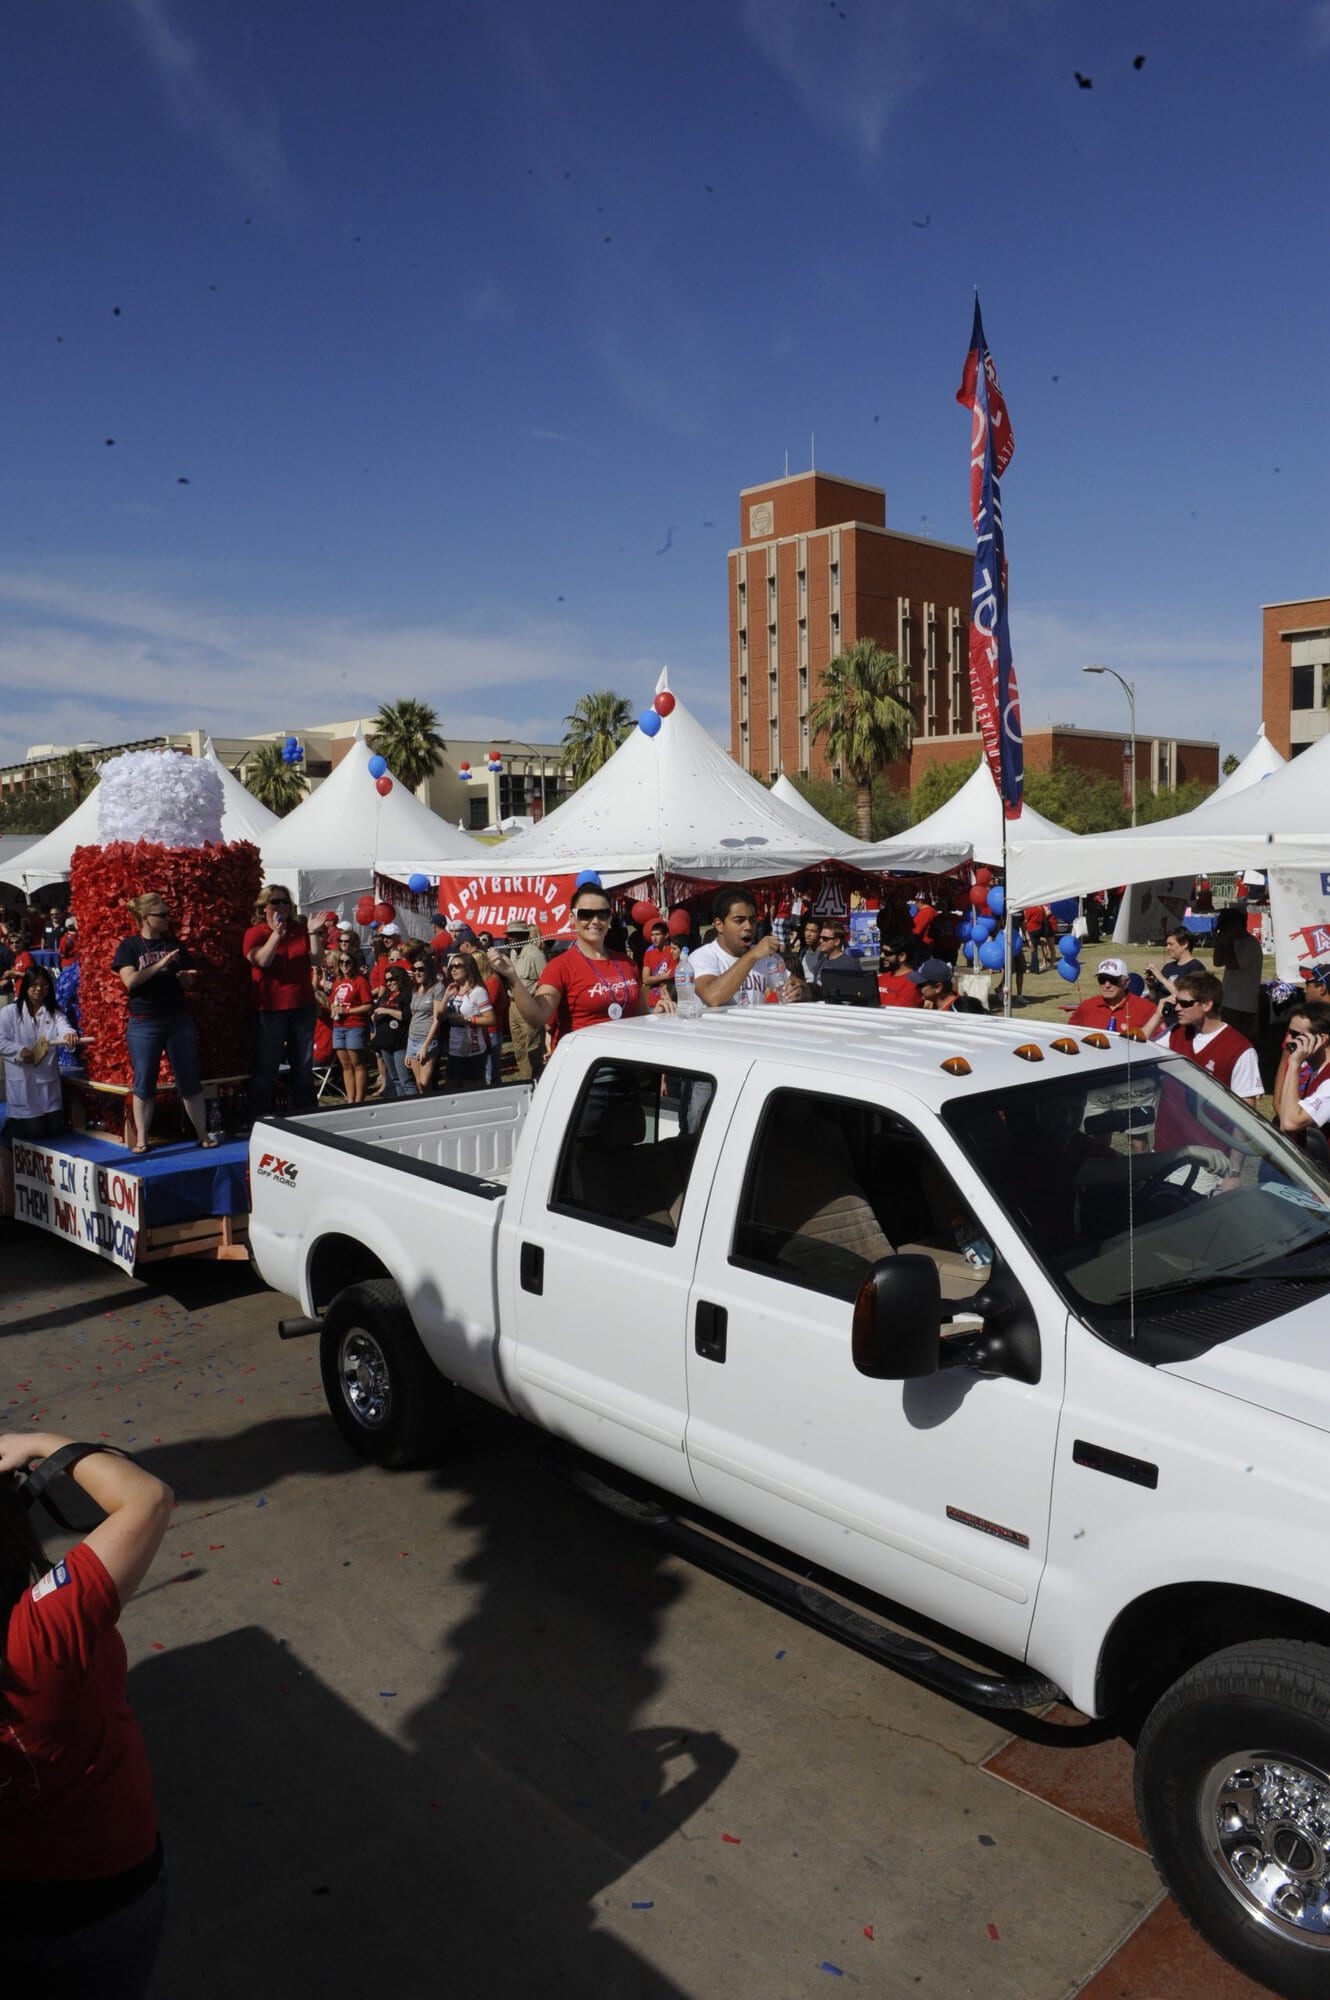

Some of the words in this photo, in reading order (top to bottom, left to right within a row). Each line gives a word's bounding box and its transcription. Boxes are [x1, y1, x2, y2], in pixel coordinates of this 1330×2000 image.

[257, 1168, 272, 1177] OFF
[272, 1175, 296, 1188] ROAD
[258, 1153, 298, 1180] FX4
[16, 1184, 49, 1224] THEM
[59, 1159, 76, 1194] IN
[97, 1170, 137, 1217] BLOW
